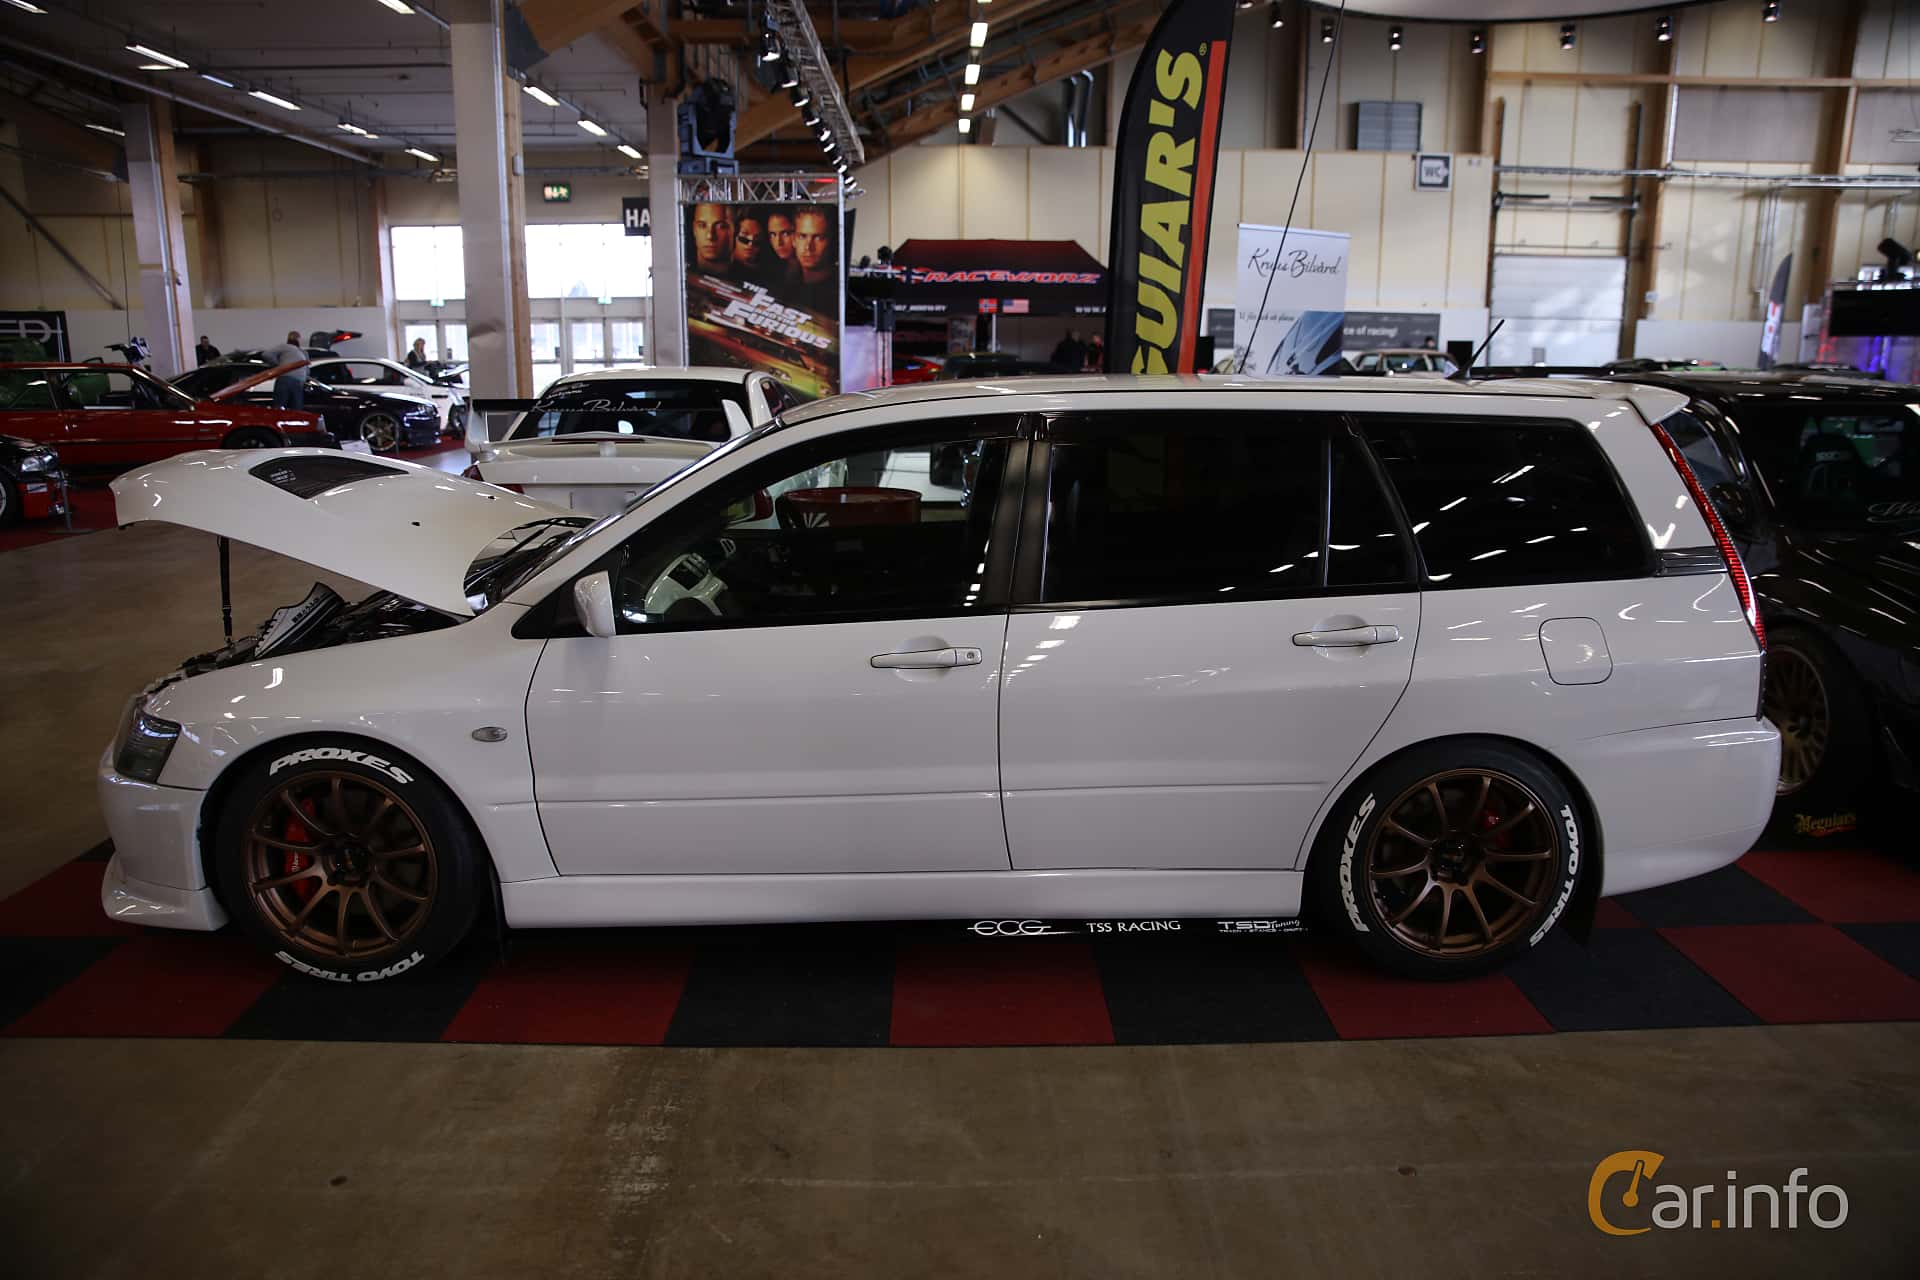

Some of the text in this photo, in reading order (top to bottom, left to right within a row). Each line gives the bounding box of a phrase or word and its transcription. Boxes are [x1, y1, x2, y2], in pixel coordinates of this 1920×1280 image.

[1424, 166, 1441, 177] WC
[743, 281, 768, 293] THE
[924, 269, 1100, 284] RACEWORZ
[751, 289, 812, 325] FAST
[722, 300, 832, 349] FURIOUS
[269, 747, 415, 784] PROXES
[1339, 792, 1376, 932] PROXES
[1529, 804, 1580, 947] TOYO TIRES
[968, 920, 1052, 936] ECG
[1086, 920, 1181, 933] TSS RACING
[274, 950, 425, 983] TOYO TIRES
